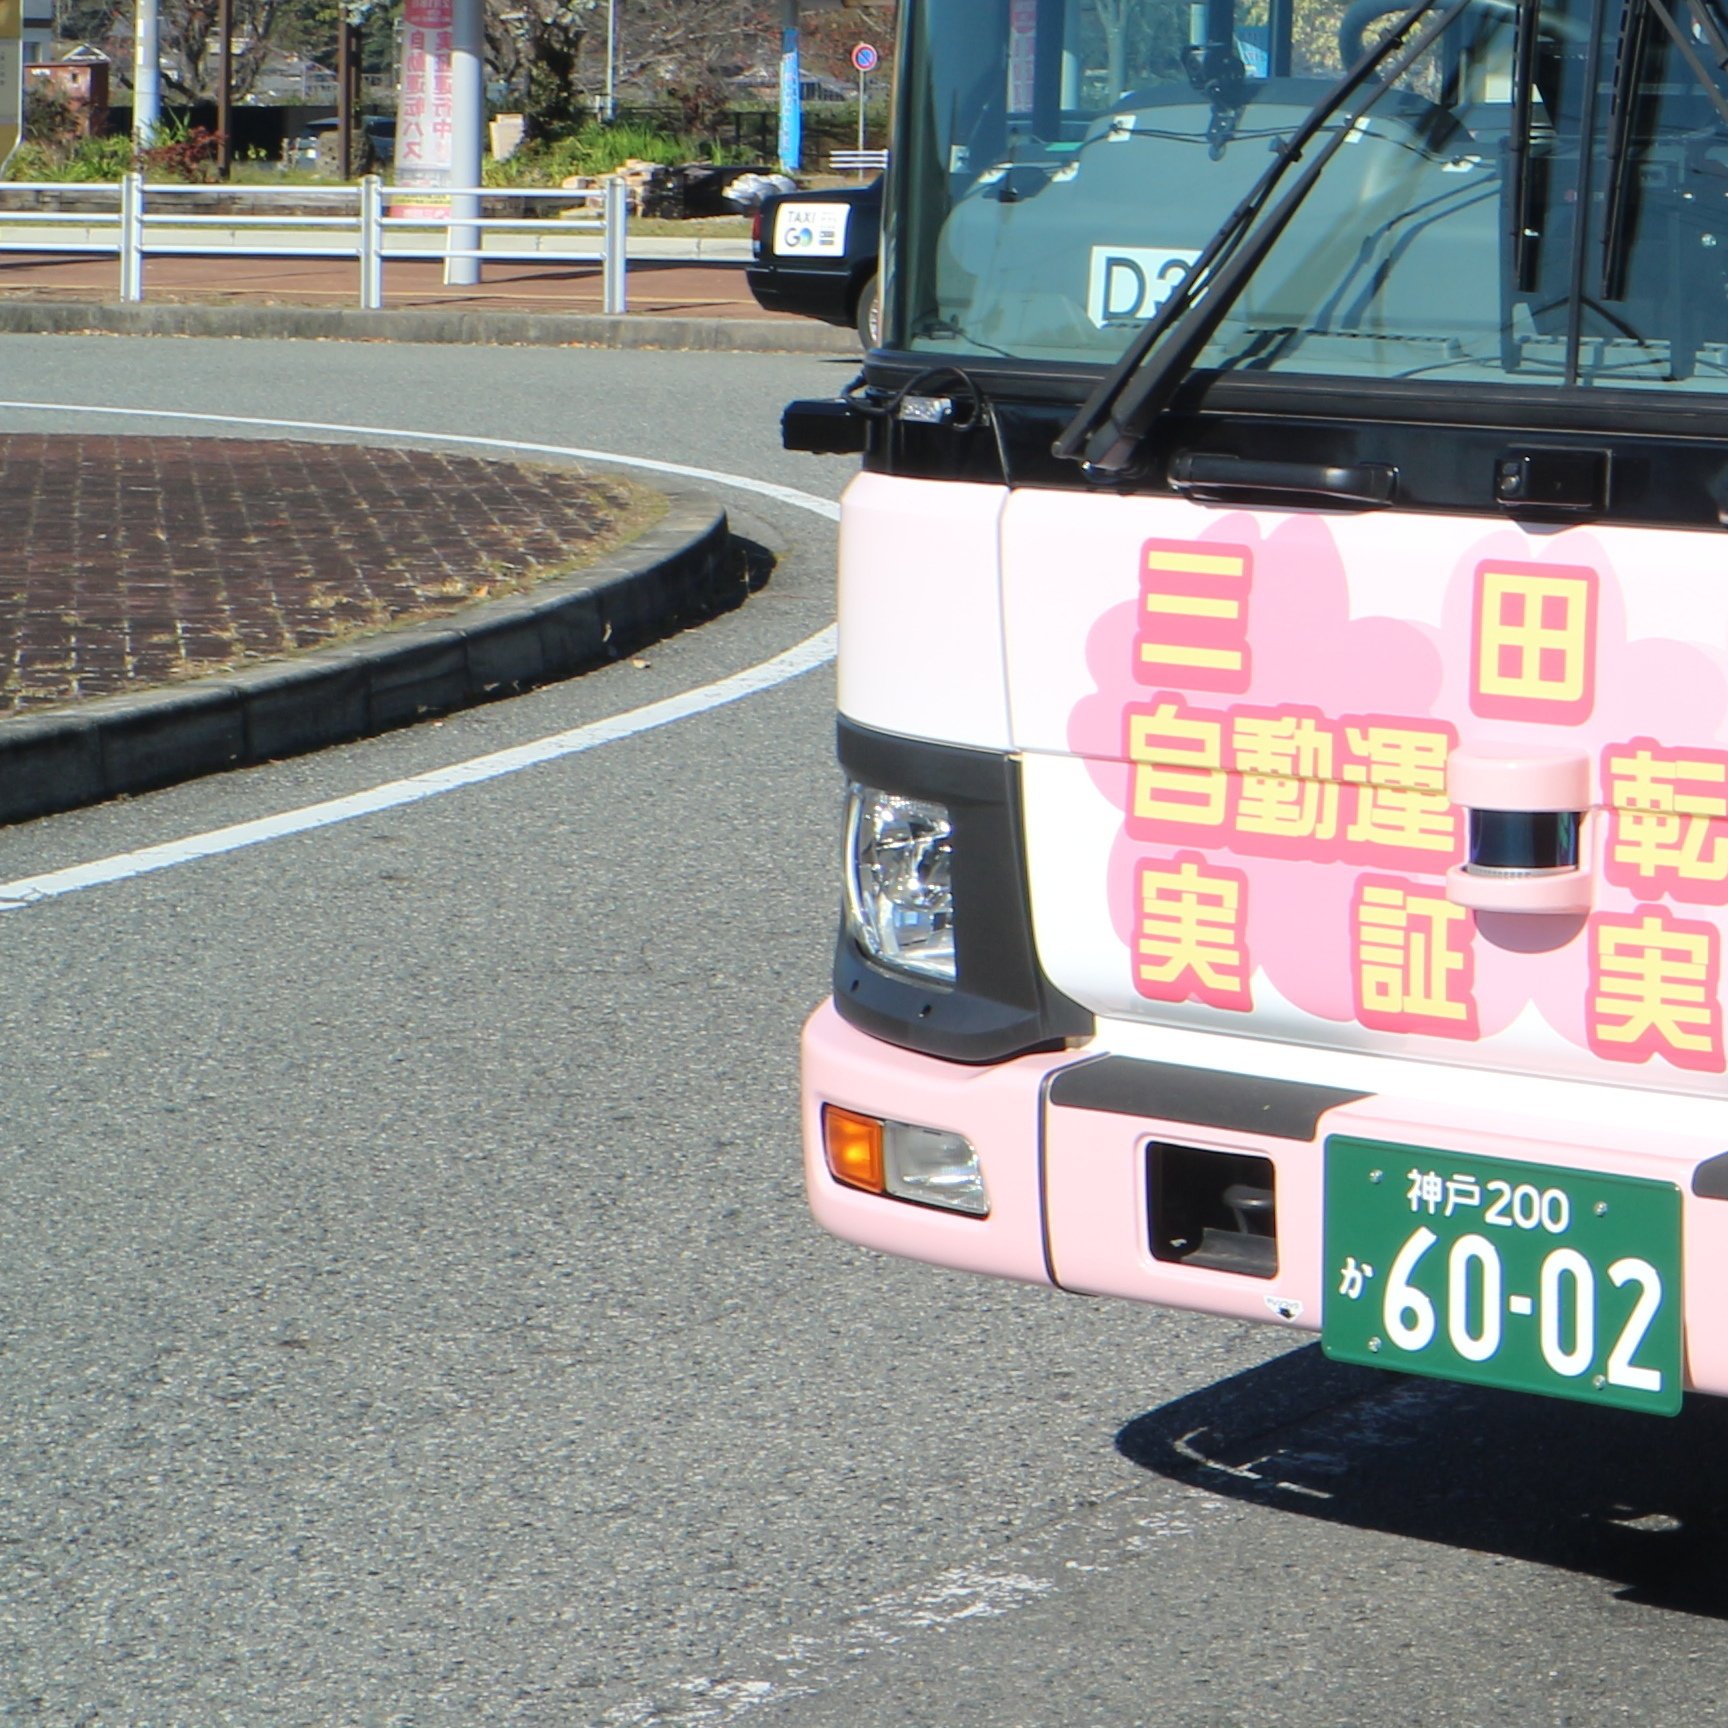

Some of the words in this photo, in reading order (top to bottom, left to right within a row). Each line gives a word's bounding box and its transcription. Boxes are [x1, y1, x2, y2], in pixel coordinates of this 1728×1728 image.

[787, 210, 817, 224] TAXI
[1338, 1256, 1374, 1300] か
[1382, 1226, 1664, 1393] 60-02
